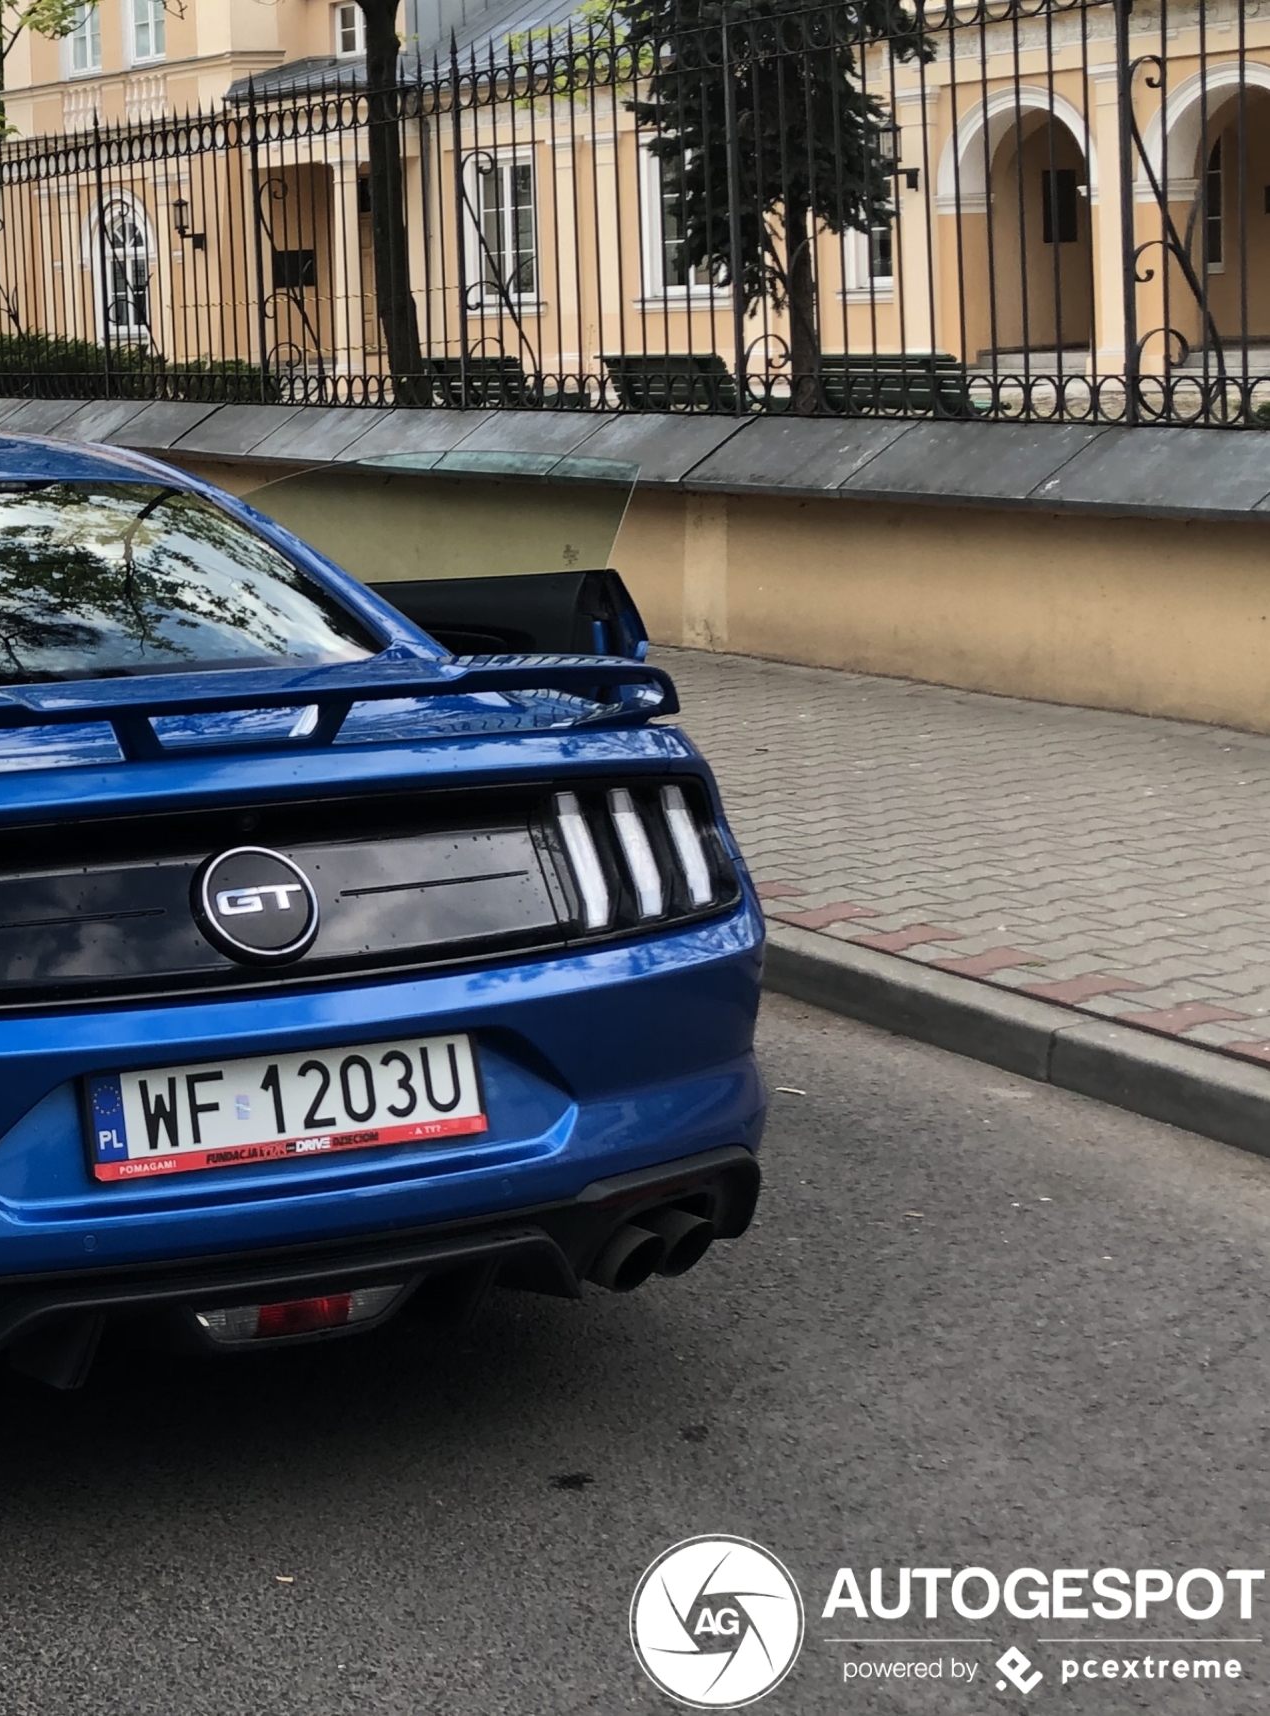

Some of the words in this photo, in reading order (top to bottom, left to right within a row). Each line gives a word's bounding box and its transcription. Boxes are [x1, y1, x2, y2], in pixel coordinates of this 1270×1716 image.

[215, 884, 302, 915] GT
[138, 1070, 224, 1150] WF
[259, 1043, 462, 1134] 1203U
[99, 1129, 124, 1150] PL
[205, 1147, 258, 1165] FUNDACJA
[296, 1136, 331, 1153] DRIVE
[333, 1131, 379, 1147] DZIECIOM
[119, 1160, 177, 1175] POMAGAM!
